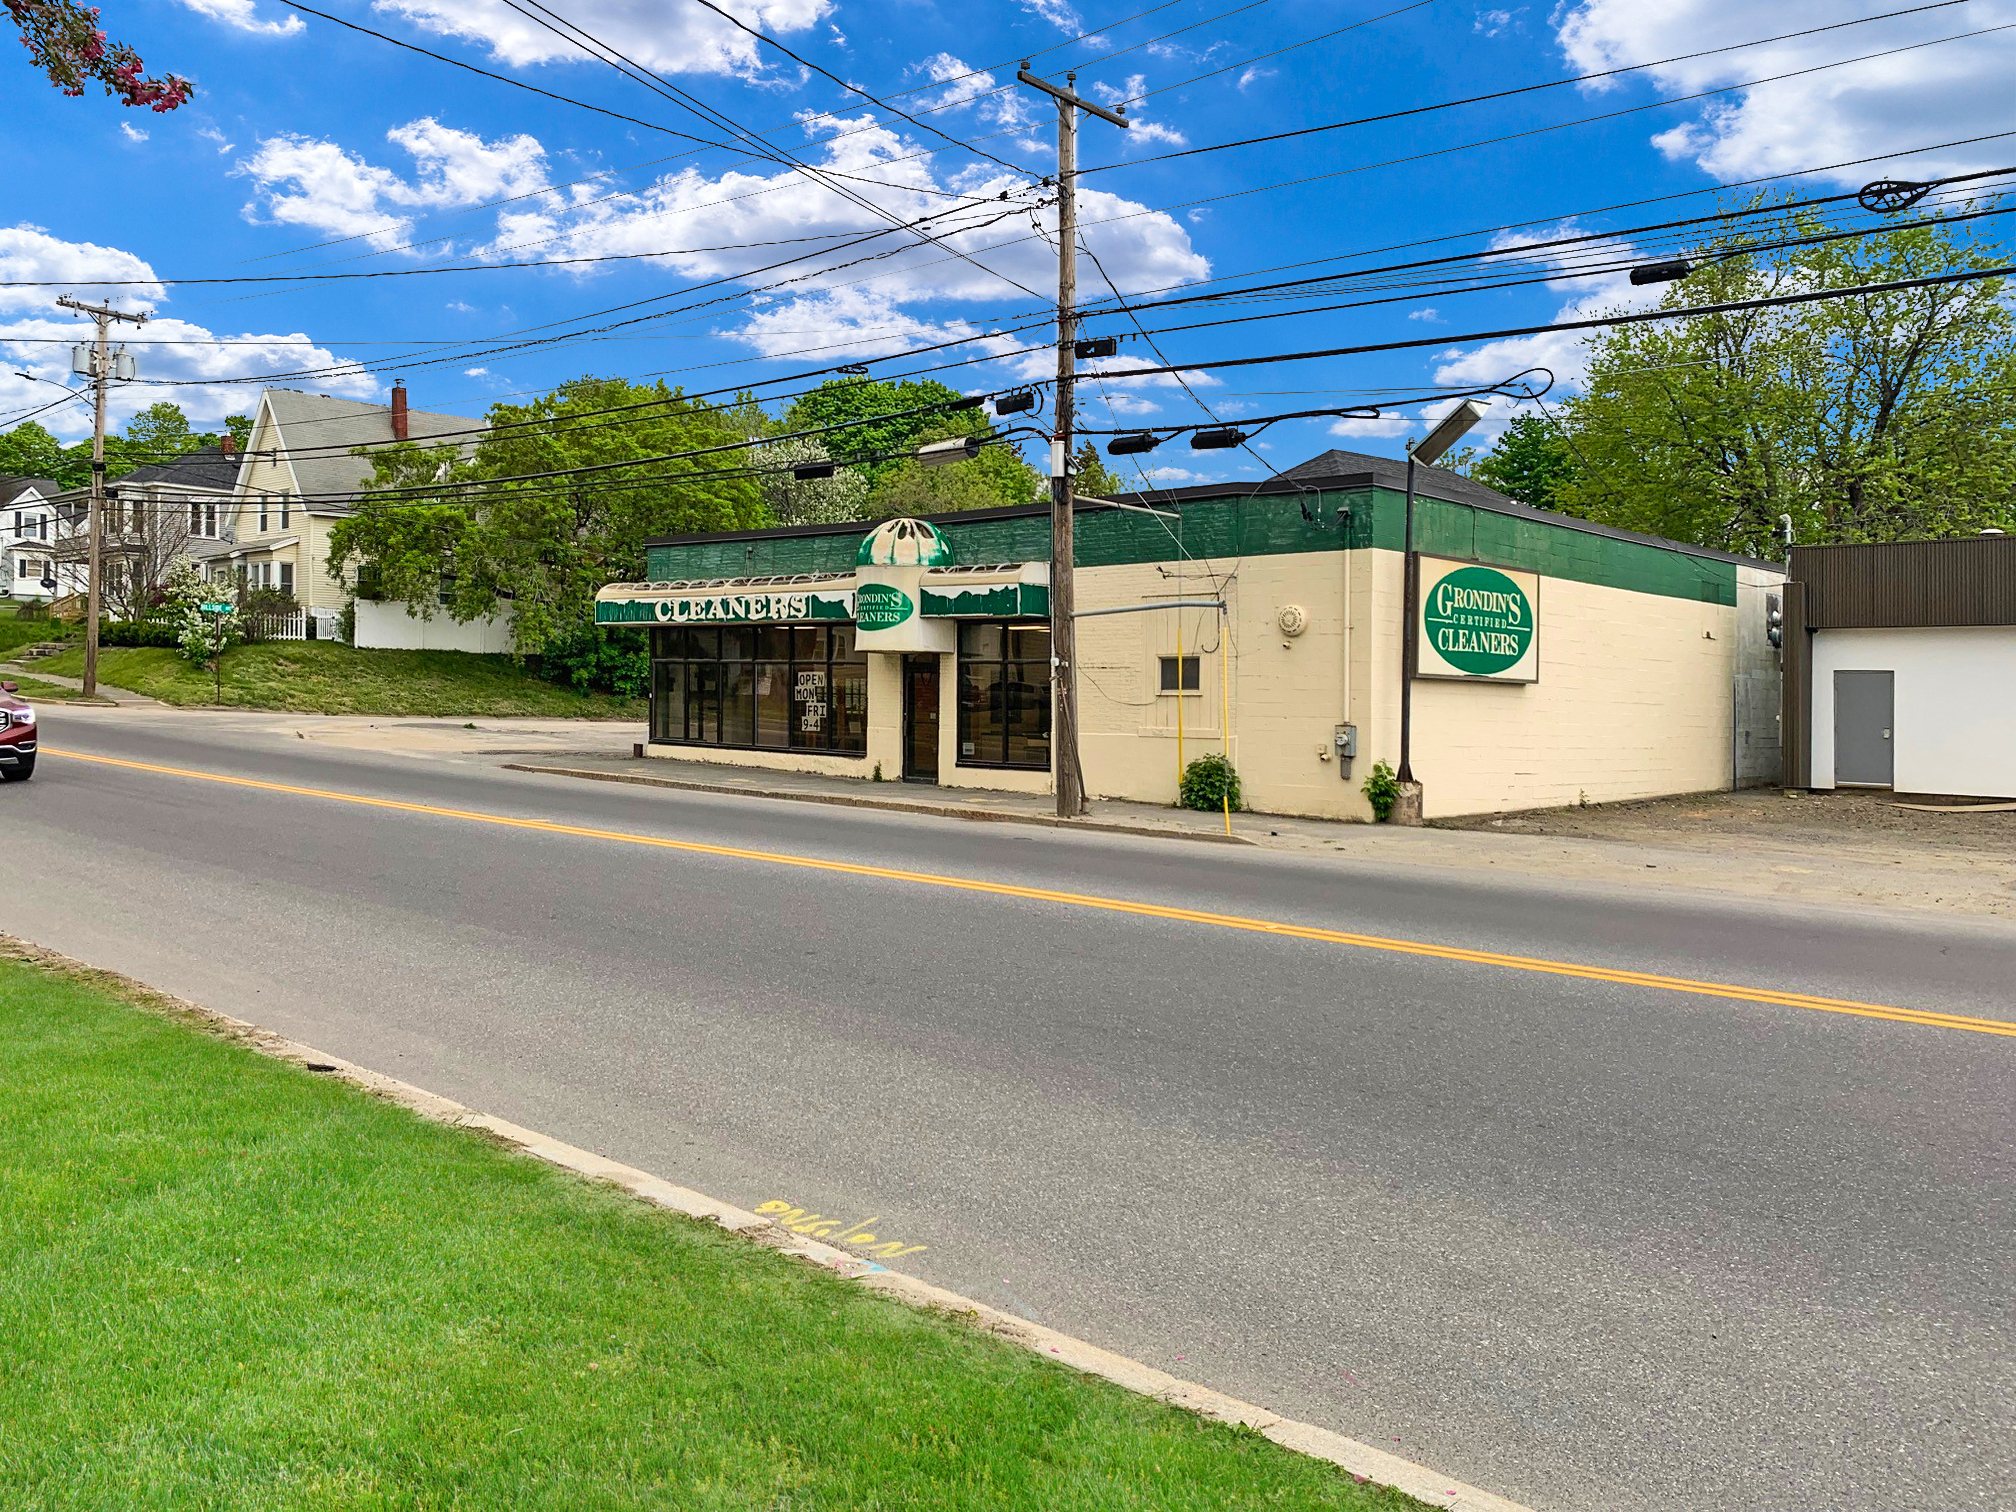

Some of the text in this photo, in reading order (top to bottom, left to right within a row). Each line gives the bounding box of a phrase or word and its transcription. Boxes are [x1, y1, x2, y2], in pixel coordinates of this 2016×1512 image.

[654, 594, 807, 622] CLEANERS
[1437, 583, 1521, 624] GRONDIN'S
[857, 611, 900, 623] LEANERS
[1453, 613, 1507, 628] CERTIFIED
[1438, 628, 1518, 655] CLEANERS
[799, 674, 824, 686] OPEN
[807, 705, 826, 717] FRI
[803, 718, 820, 730] 9-4
